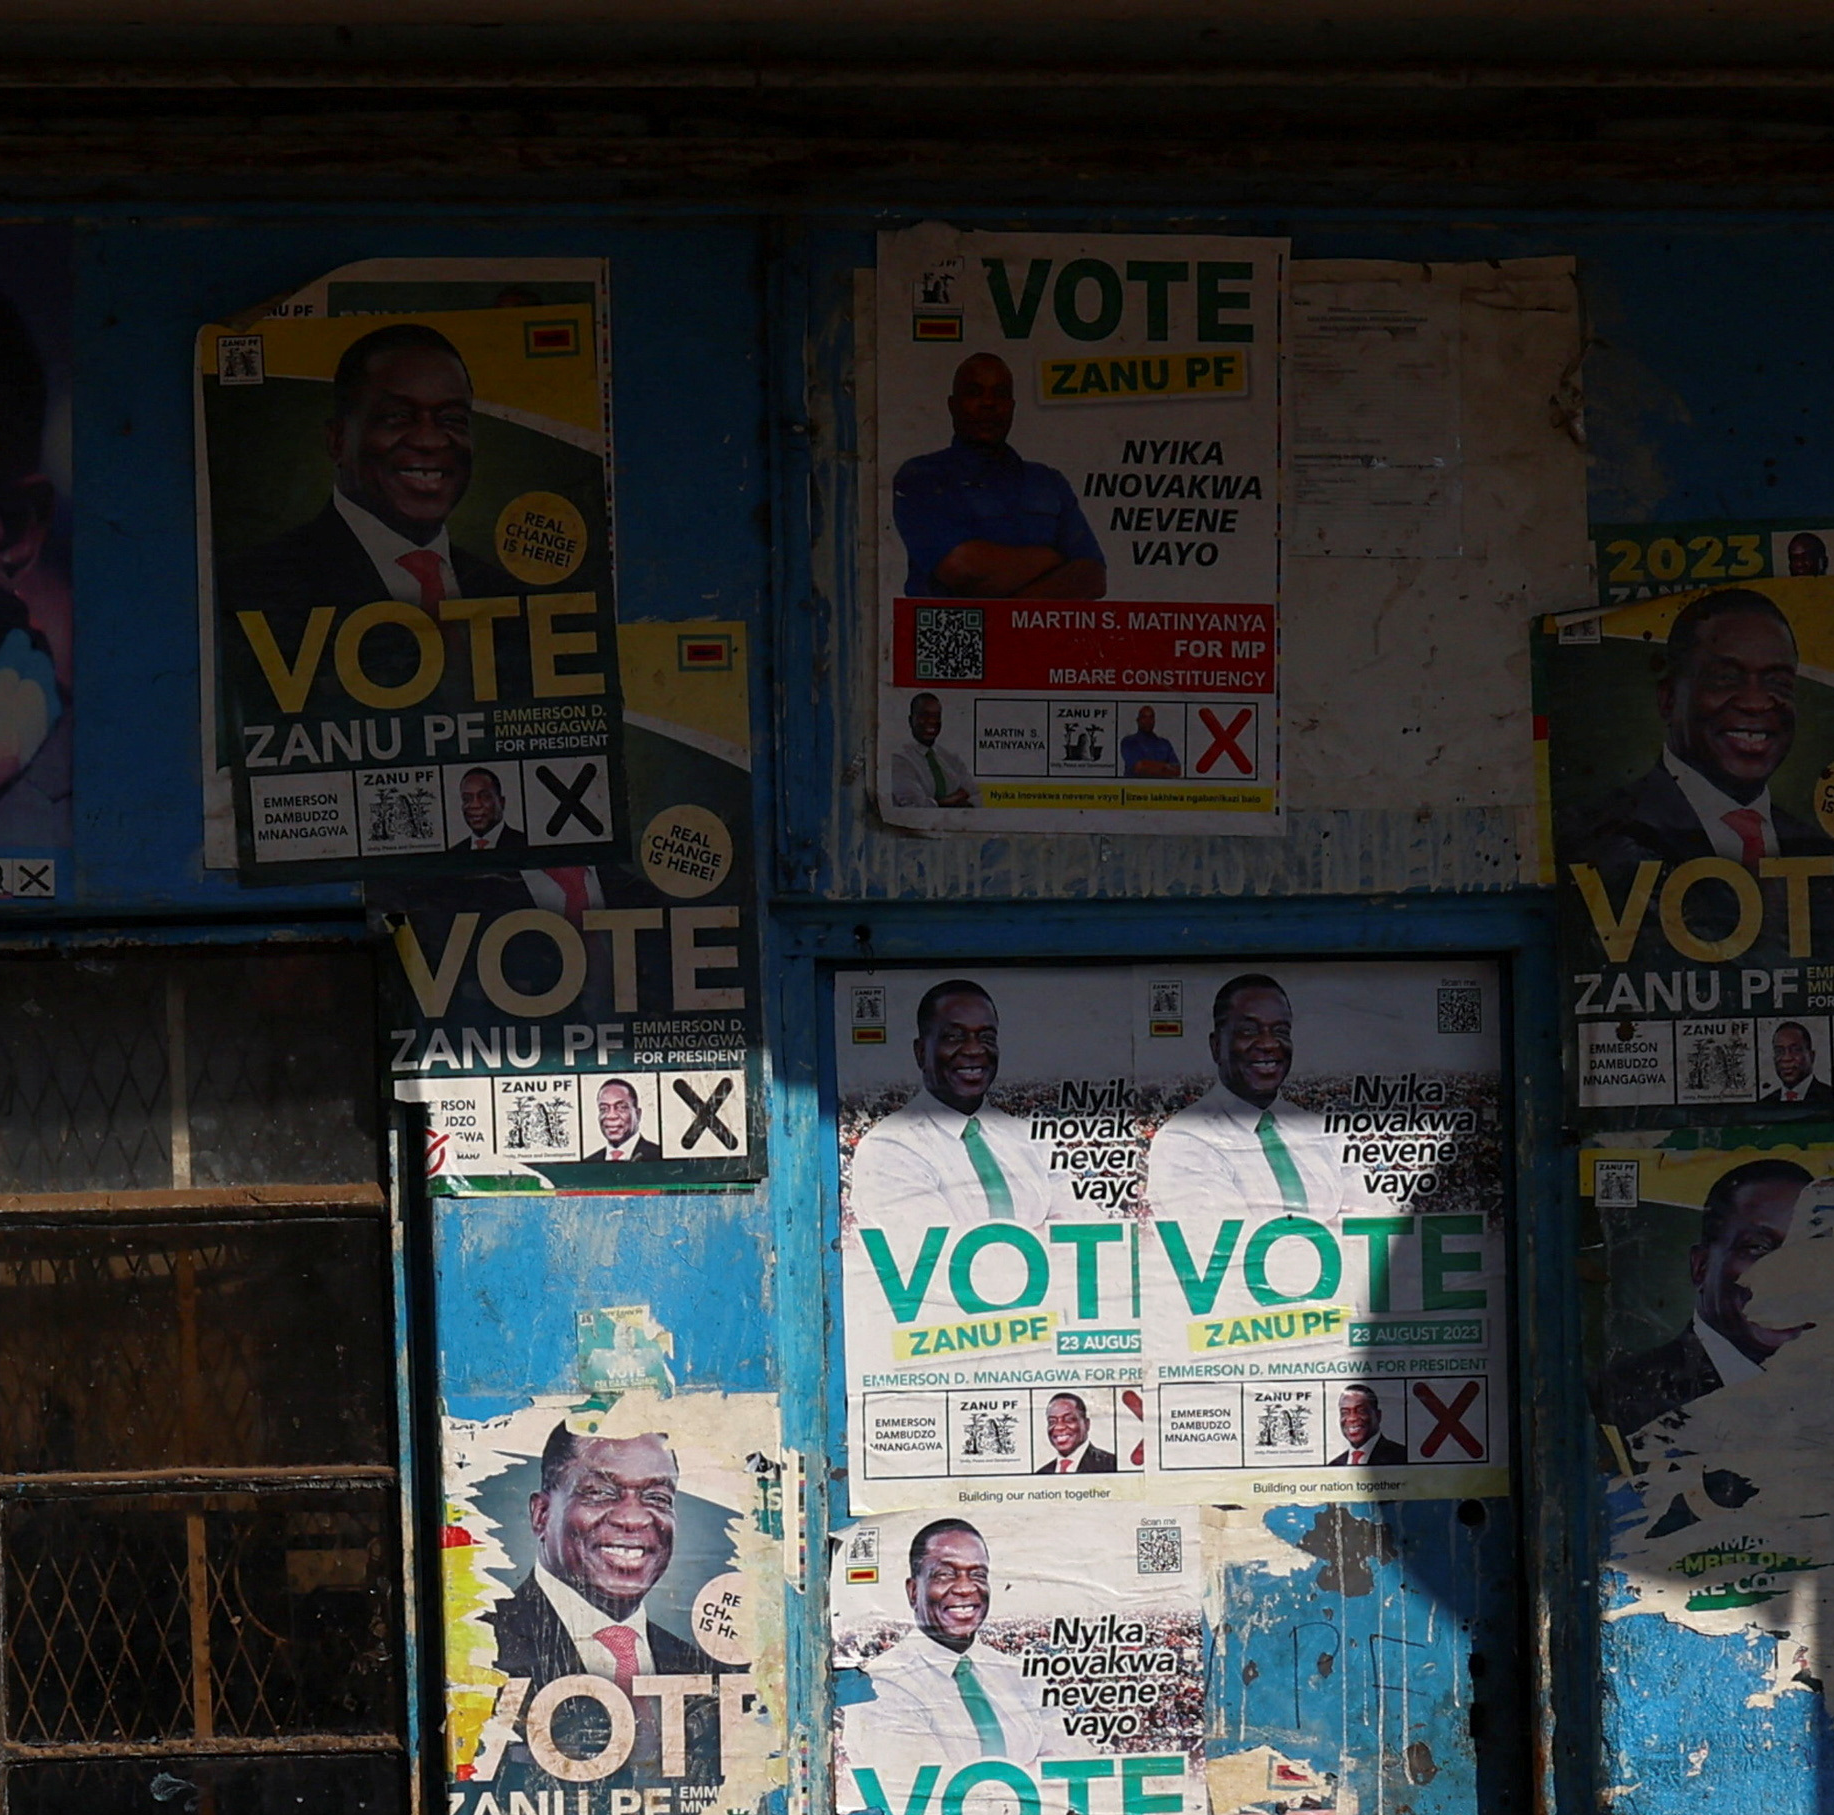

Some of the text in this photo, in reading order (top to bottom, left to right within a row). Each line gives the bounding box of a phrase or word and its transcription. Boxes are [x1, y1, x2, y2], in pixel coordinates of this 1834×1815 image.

[982, 259, 1254, 342] VOTE
[1051, 357, 1234, 394] ZANU PF
[1122, 440, 1223, 465] NYIKA
[1083, 473, 1262, 500] INOVAKWA
[524, 510, 565, 534] REAL
[1110, 508, 1238, 532] NEVENE
[504, 538, 570, 569] IS HERE!
[506, 522, 576, 555] CHANGE
[1132, 542, 1218, 566] VAYO
[1605, 534, 1766, 583] 2023
[1011, 611, 1266, 632] MARTIN S. MATINYANYA
[236, 591, 606, 714] VOTE
[1174, 640, 1266, 659] FOR MP
[1048, 669, 1266, 687] MBARE CONSTITUENCY
[492, 704, 607, 723] EMMERSON D.
[495, 719, 607, 738] MNANGAGWA
[244, 714, 484, 768] ZANU PF
[383, 906, 745, 1018] VOTE
[1574, 968, 1798, 1015] ZANU PF
[391, 1023, 625, 1072] ZANU PF
[1155, 1216, 1487, 1314] VOTE
